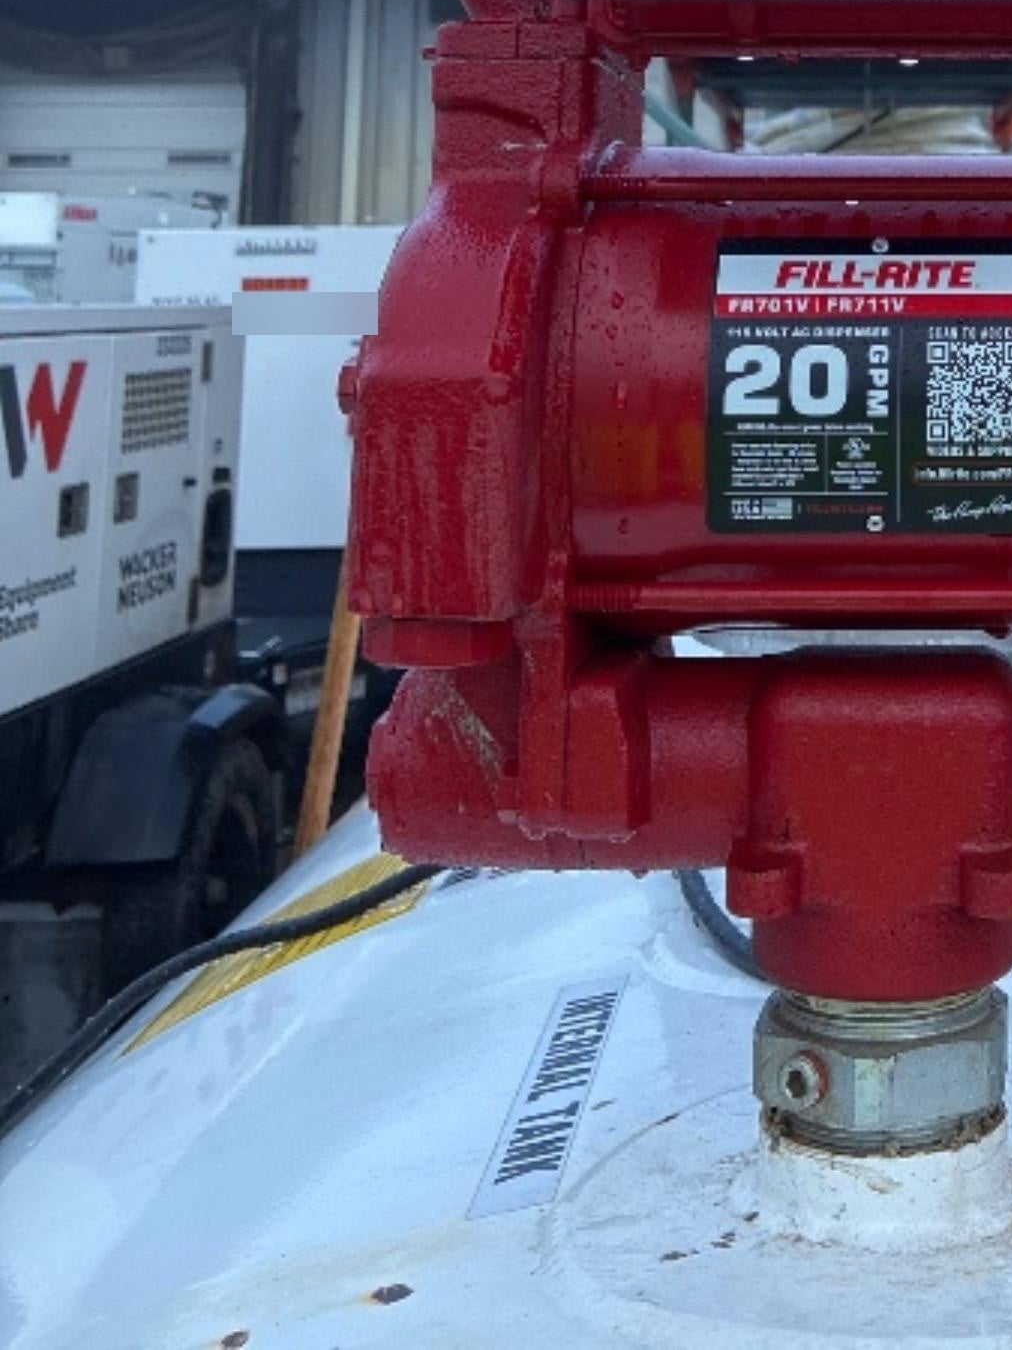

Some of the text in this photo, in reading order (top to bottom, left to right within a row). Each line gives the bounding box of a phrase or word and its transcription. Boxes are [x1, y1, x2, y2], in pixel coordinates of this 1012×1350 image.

[774, 260, 977, 290] FILL-RITE
[828, 298, 907, 314] FR711V
[722, 344, 889, 418] 20 GPM
[118, 541, 177, 581] WACKER
[117, 571, 177, 613] NEUSON
[494, 991, 618, 1186] INTERNAL TANK
